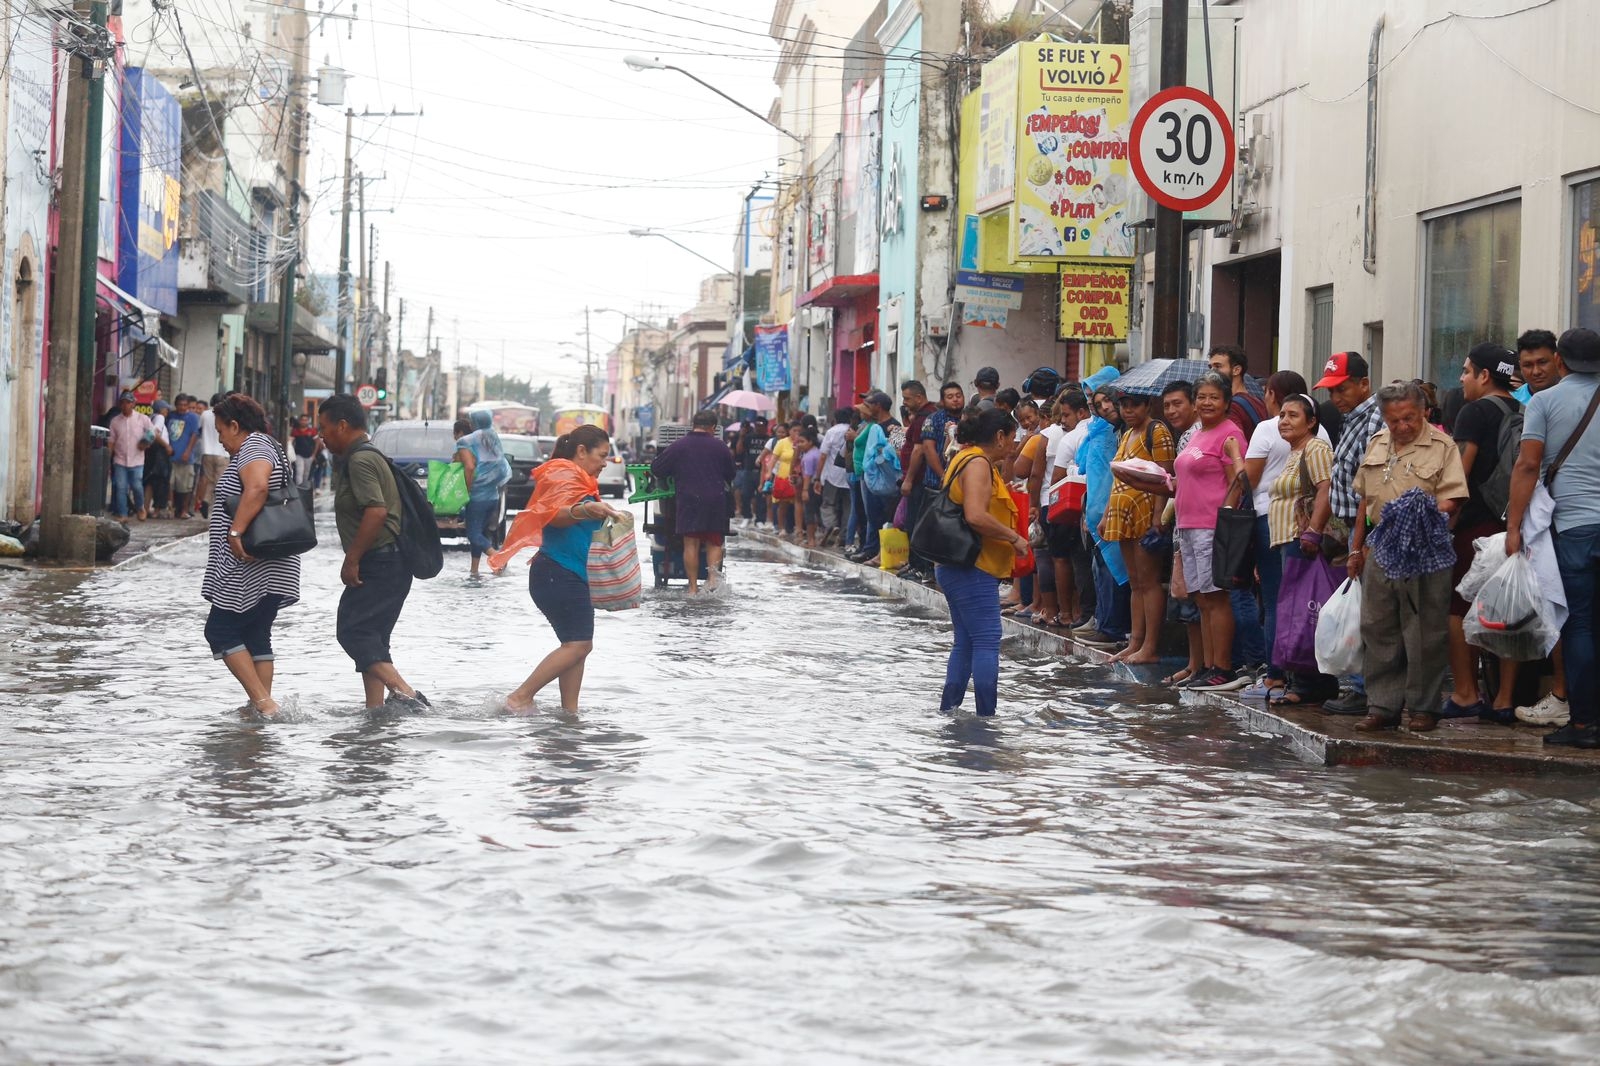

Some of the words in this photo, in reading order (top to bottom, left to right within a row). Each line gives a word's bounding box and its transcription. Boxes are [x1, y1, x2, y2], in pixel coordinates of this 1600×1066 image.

[1038, 48, 1054, 63] SE
[1059, 49, 1085, 64] FUE
[1090, 50, 1101, 64] Y
[1047, 66, 1105, 85] VOLVIÓ
[1041, 93, 1051, 102] Tu
[1053, 95, 1073, 103] casa
[1075, 94, 1085, 103] de
[1087, 94, 1122, 106] empeño
[1156, 111, 1212, 165] 30
[1163, 170, 1204, 186] km/h
[1063, 271, 1127, 289] EMPEÑOS
[1067, 290, 1122, 305] COMPRA
[1080, 306, 1108, 320] ORO
[1073, 322, 1114, 336] PLATA
[361, 388, 374, 399] 30
